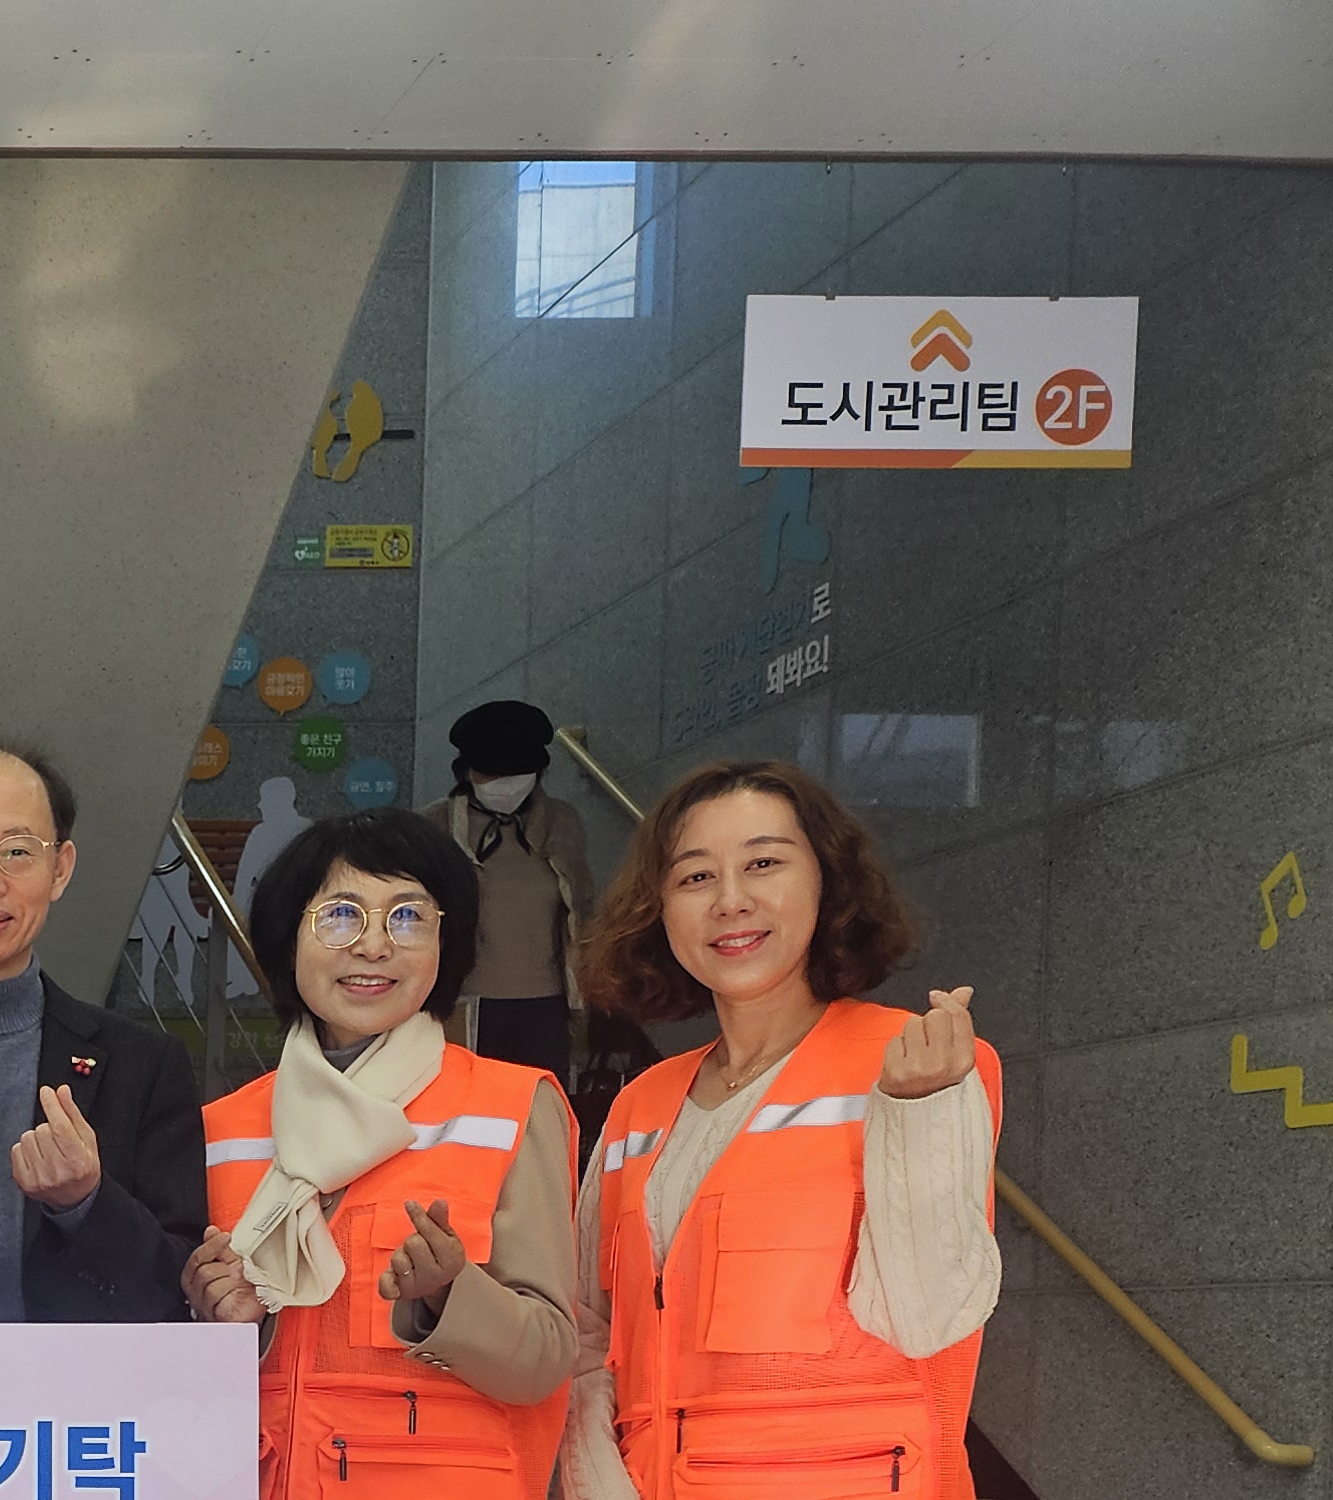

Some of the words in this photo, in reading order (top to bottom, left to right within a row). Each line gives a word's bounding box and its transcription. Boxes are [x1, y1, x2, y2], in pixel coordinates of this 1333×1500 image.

[781, 381, 1018, 433] 도시관리팀
[1044, 385, 1106, 430] 2F
[766, 635, 829, 694] 돼봐요!
[301, 734, 319, 745] 좋은
[323, 733, 342, 745] 친구
[306, 746, 335, 758] 가지기
